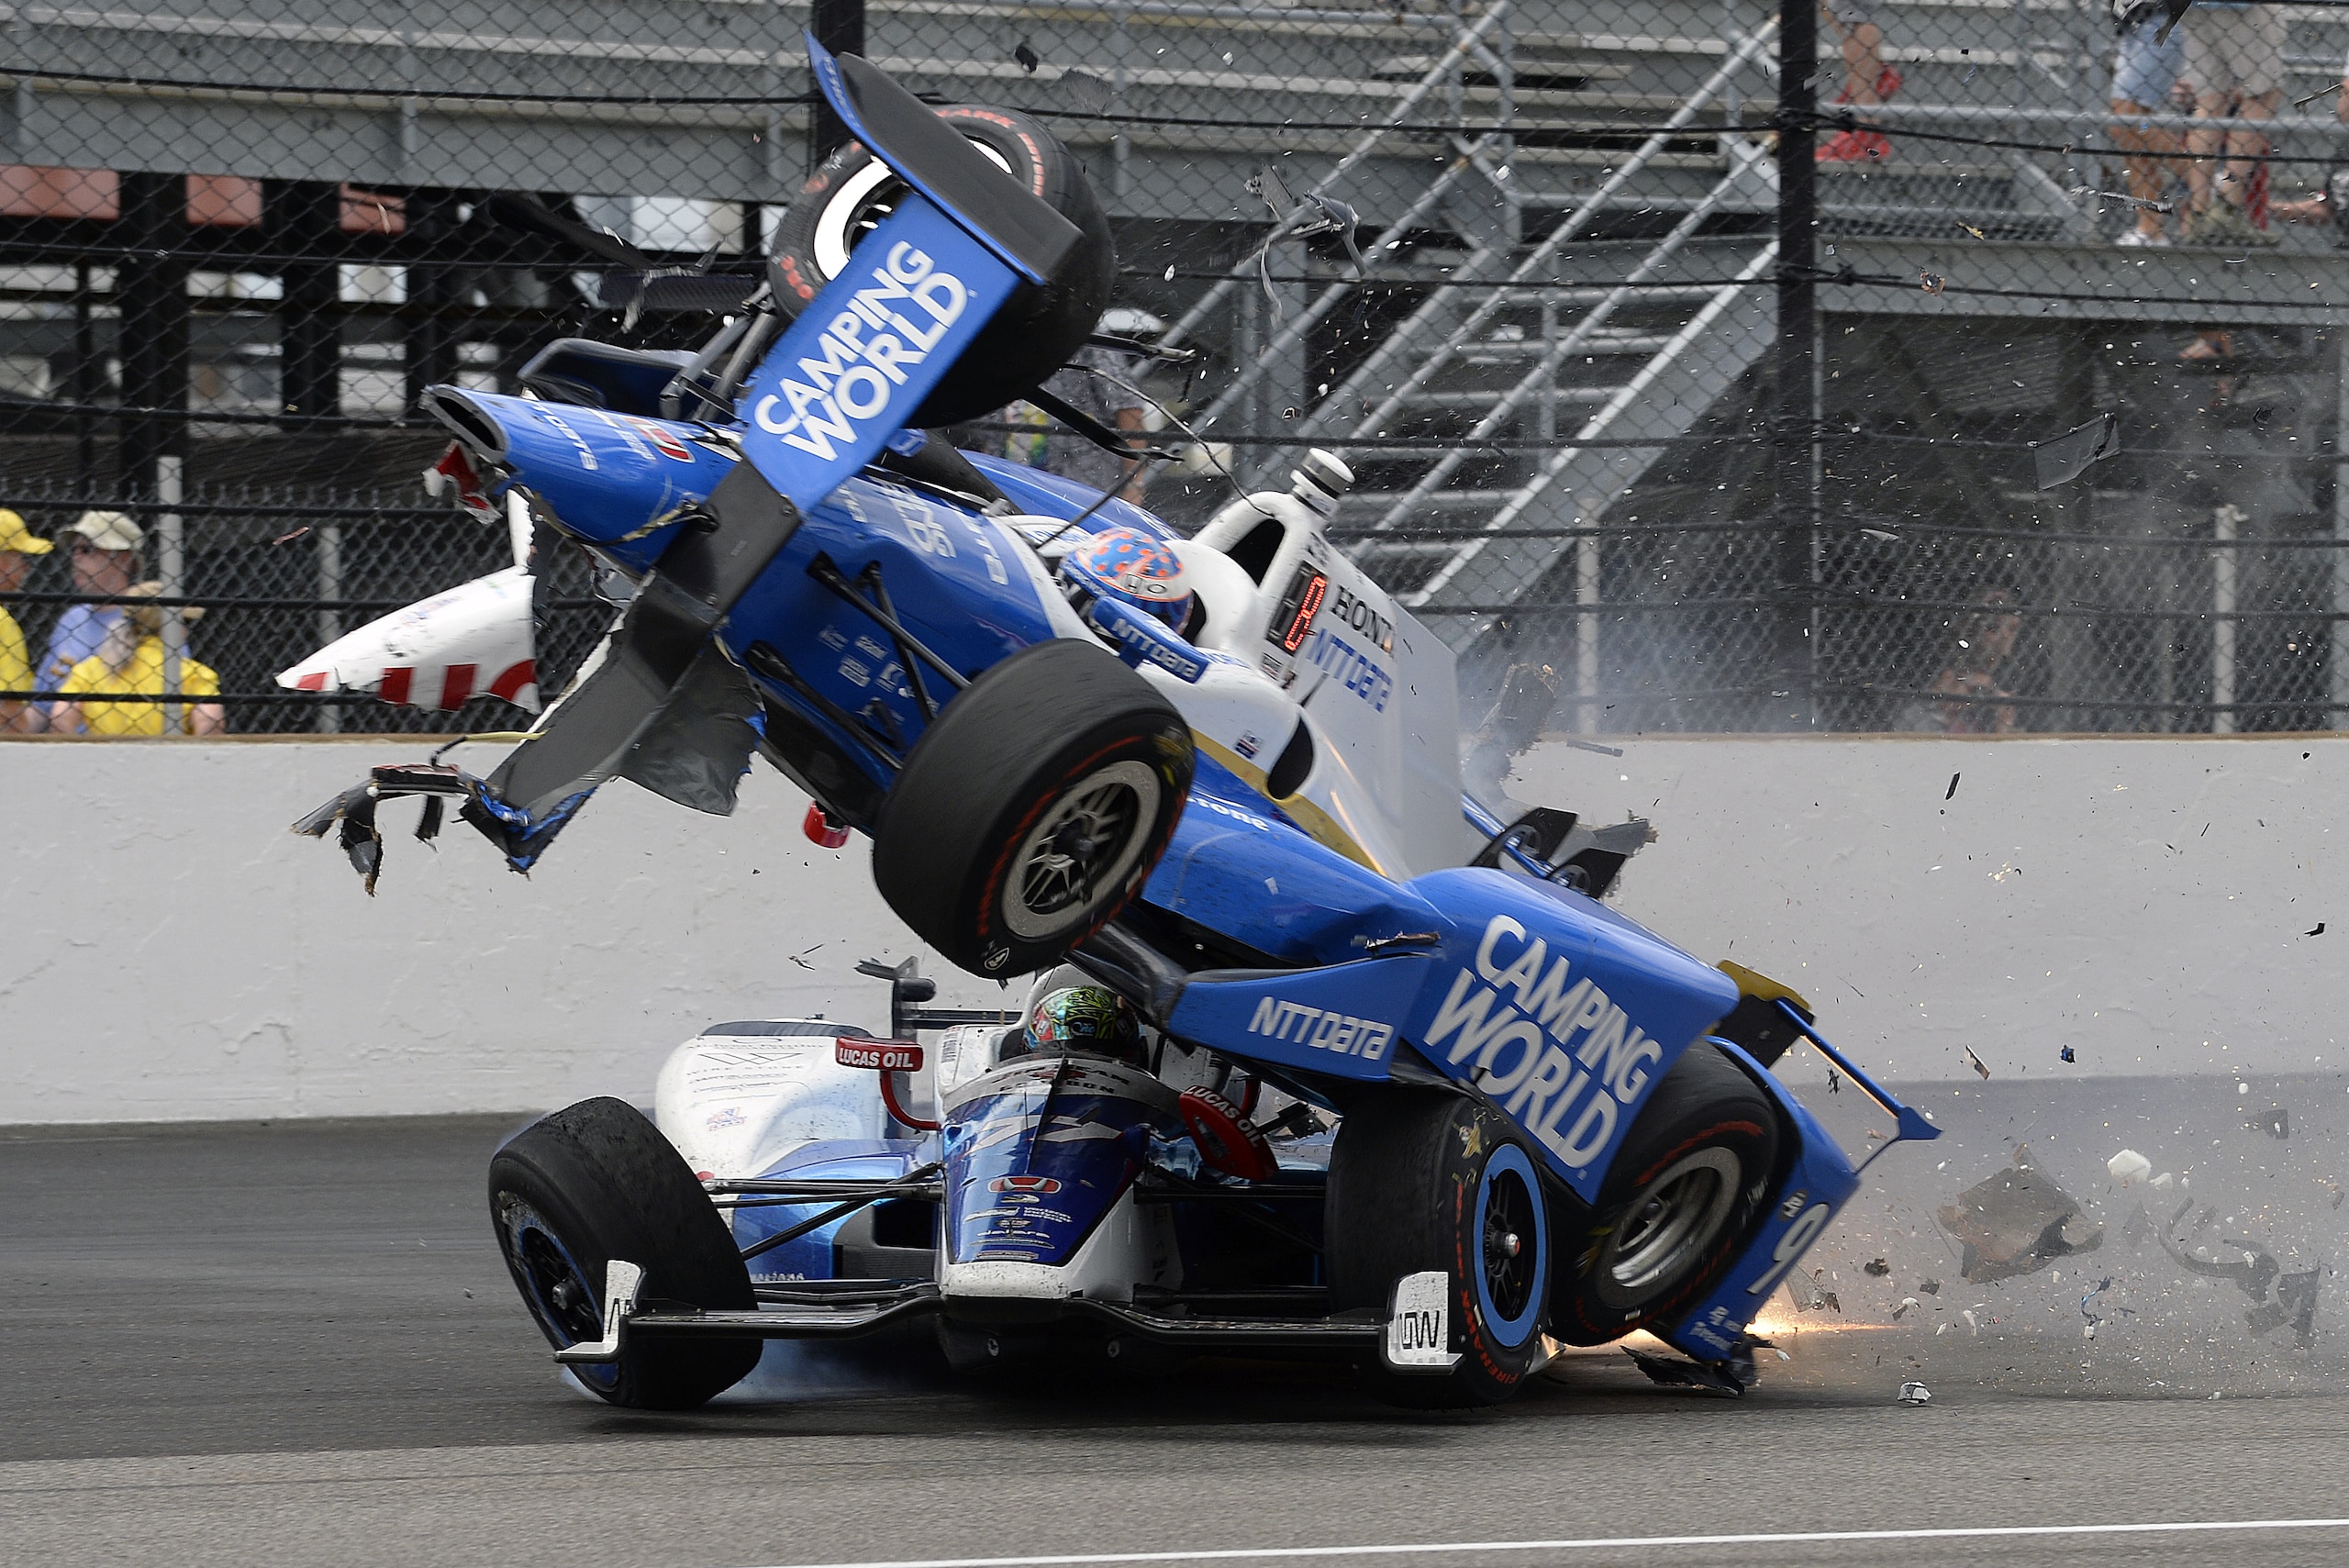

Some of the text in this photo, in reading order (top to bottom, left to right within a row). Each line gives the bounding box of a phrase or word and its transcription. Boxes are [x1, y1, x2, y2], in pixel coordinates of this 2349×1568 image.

[754, 240, 934, 435] CAMPING
[781, 272, 969, 463] WORLD
[839, 1048, 914, 1068] LUCAS OIL
[1423, 967, 1618, 1168] WORLD
[1475, 915, 1663, 1104] CAMPING
[1184, 1085, 1263, 1148] LUCAS OIL
[1746, 1203, 1830, 1295] 9
